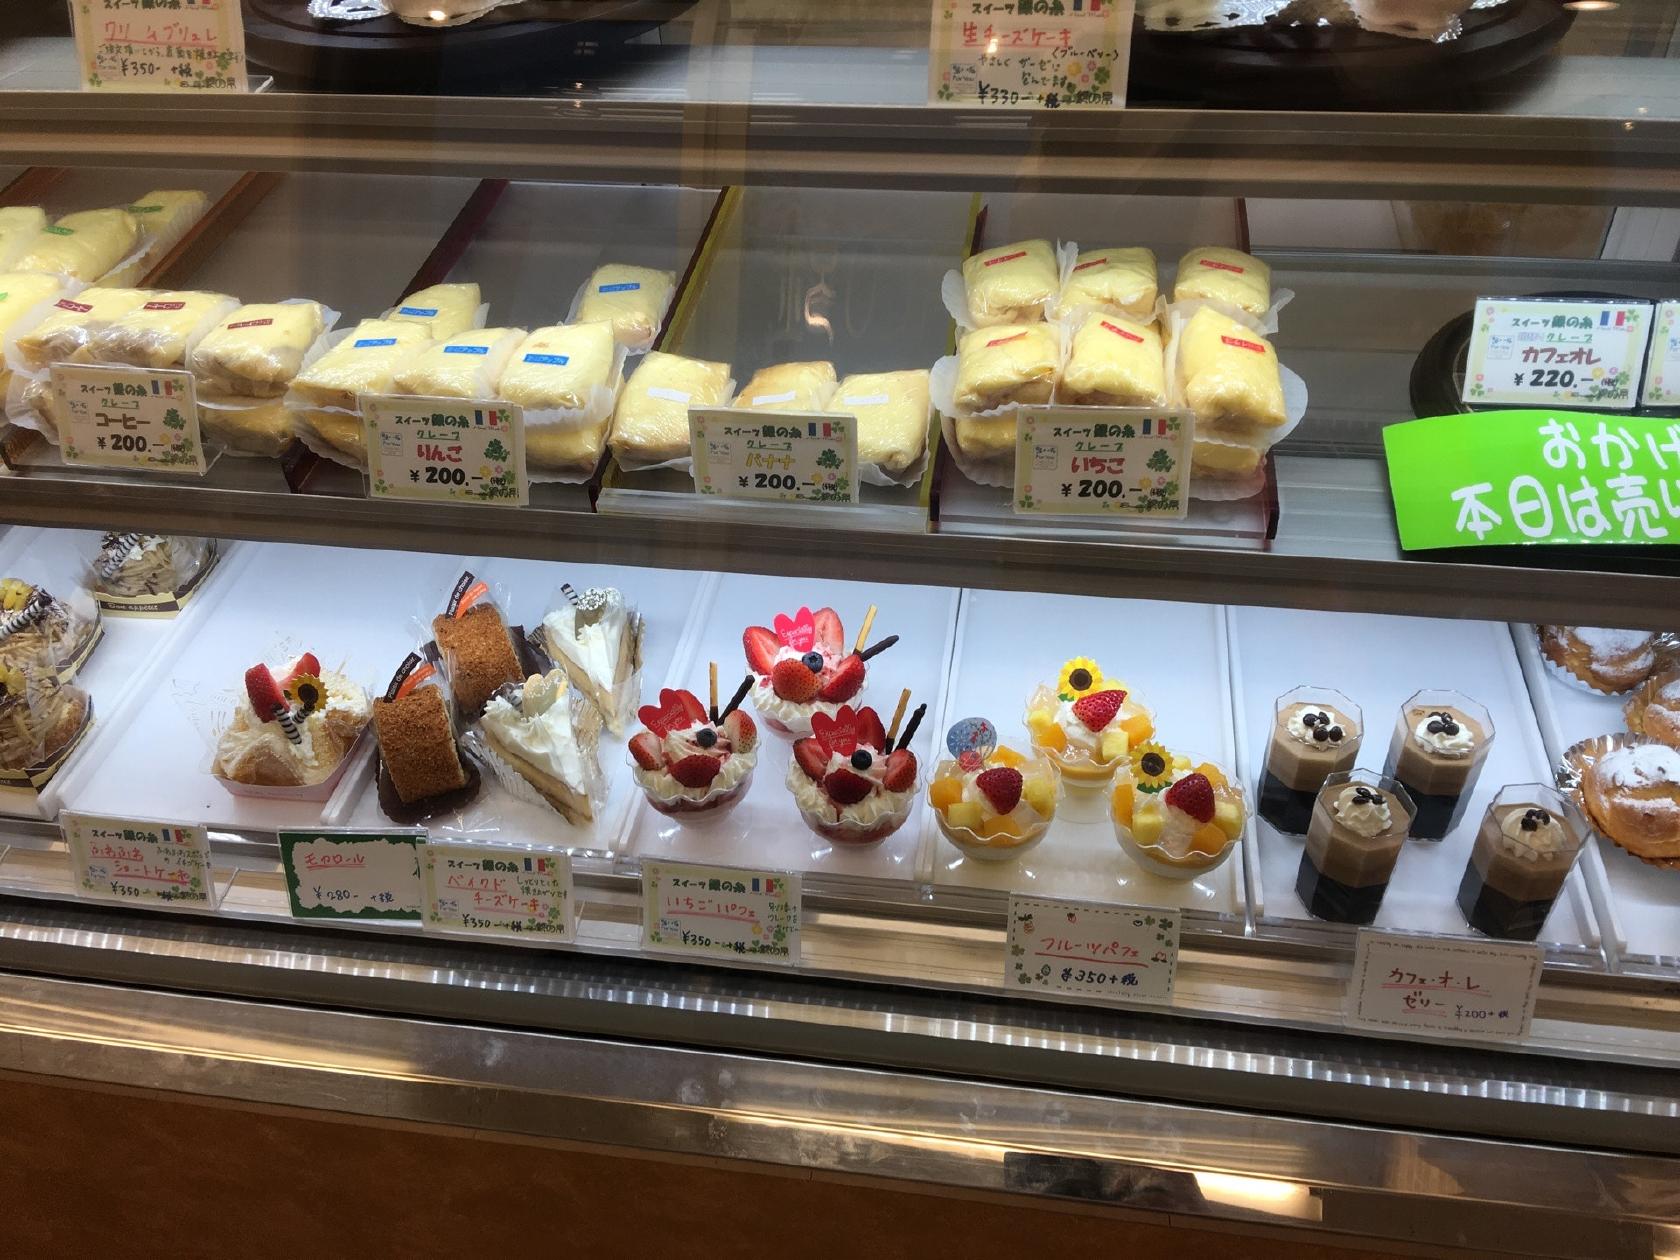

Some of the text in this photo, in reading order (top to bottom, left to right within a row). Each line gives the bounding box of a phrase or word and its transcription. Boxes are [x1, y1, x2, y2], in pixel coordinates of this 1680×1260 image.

[1522, 346, 1602, 365] カフェオレ
[96, 412, 151, 430] コーヒー
[746, 452, 796, 470] バナナ
[448, 874, 507, 891] ベイクド
[473, 892, 540, 912] チーズケーキ
[666, 896, 756, 918] いちごパフェ
[1040, 937, 1140, 958] フルーツパフェ
[1402, 990, 1447, 1010] ゼリー
